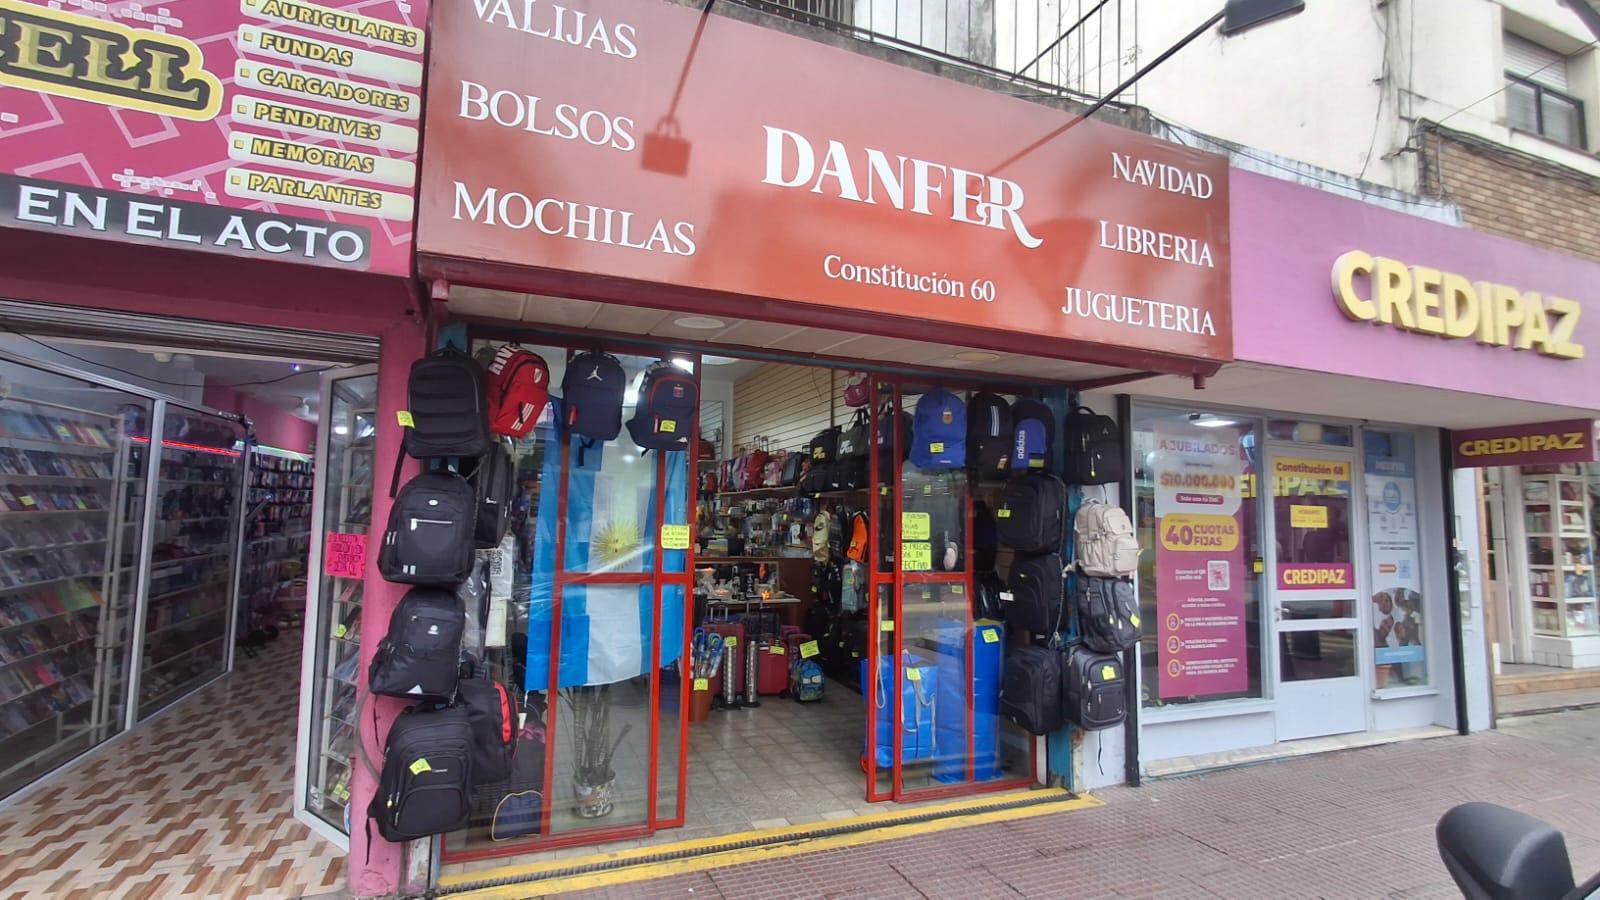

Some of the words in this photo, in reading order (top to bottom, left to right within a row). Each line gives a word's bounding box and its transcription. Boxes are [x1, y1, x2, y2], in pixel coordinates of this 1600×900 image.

[261, 0, 417, 48] AURICULARES
[0, 17, 200, 101] ELL
[260, 34, 353, 67] FUNDAS
[256, 68, 410, 112] CARGADORES
[254, 104, 381, 140] PENDRIVES
[458, 80, 636, 151] BOLSOS
[250, 138, 374, 173] MEMORIAS
[1112, 152, 1213, 200] NAVIDAD
[247, 174, 382, 209] PARLANTES
[761, 125, 1044, 249] DANFER
[16, 184, 108, 231] EN
[125, 200, 202, 244] EL
[214, 215, 365, 263] ACTO
[452, 181, 697, 256] MOCHILAS
[1099, 220, 1215, 268] LIBRERIA
[823, 254, 965, 298] Constitución
[970, 279, 996, 302] 60
[1061, 286, 1217, 336] JUGUETERIA
[1331, 250, 1584, 360] CREDIPAZ
[1016, 430, 1026, 460] adidas
[1459, 432, 1584, 456] CREDIPAZ
[1276, 461, 1332, 474] Constitución
[1166, 525, 1193, 546] 40
[1193, 524, 1234, 535] CUOTAS
[1194, 536, 1222, 546] FIJAS
[1283, 568, 1345, 585] CREDIPAZ
